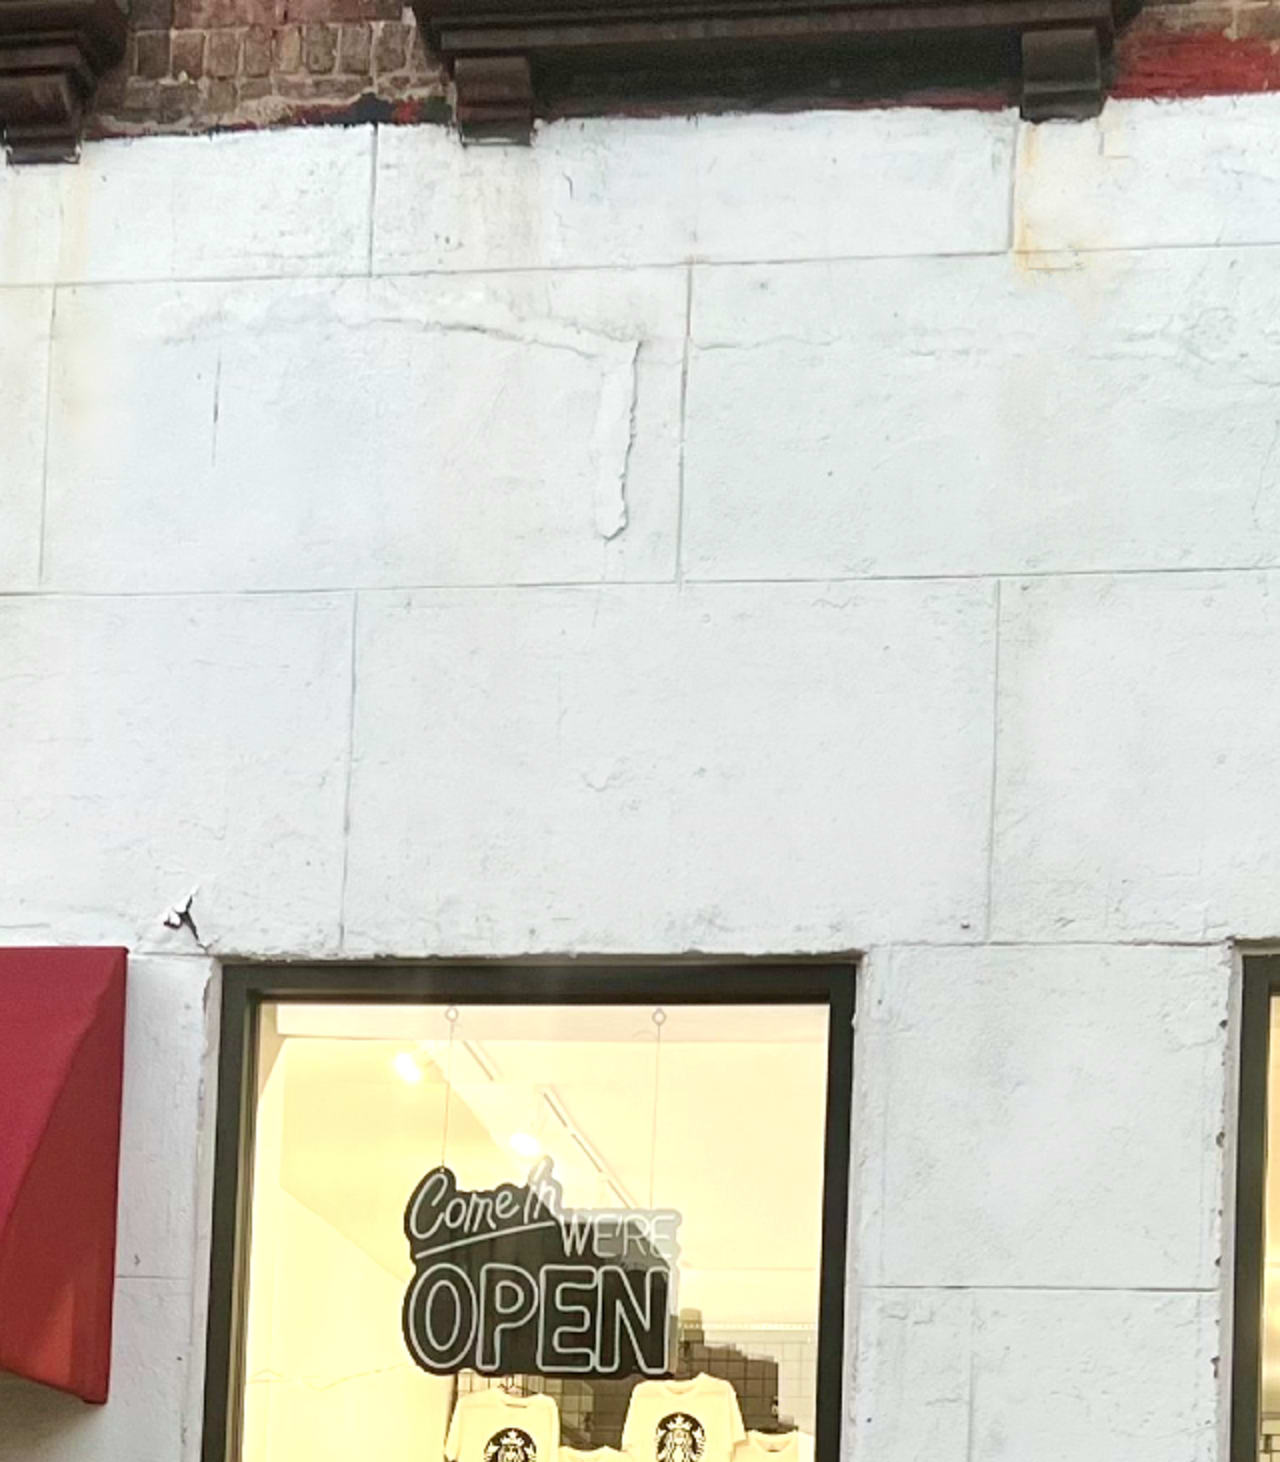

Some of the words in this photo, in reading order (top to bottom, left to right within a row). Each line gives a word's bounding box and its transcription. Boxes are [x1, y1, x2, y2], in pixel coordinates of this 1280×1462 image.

[410, 1172, 520, 1239] Come
[558, 1213, 677, 1258] WE'RE
[409, 1262, 671, 1375] OPEN
